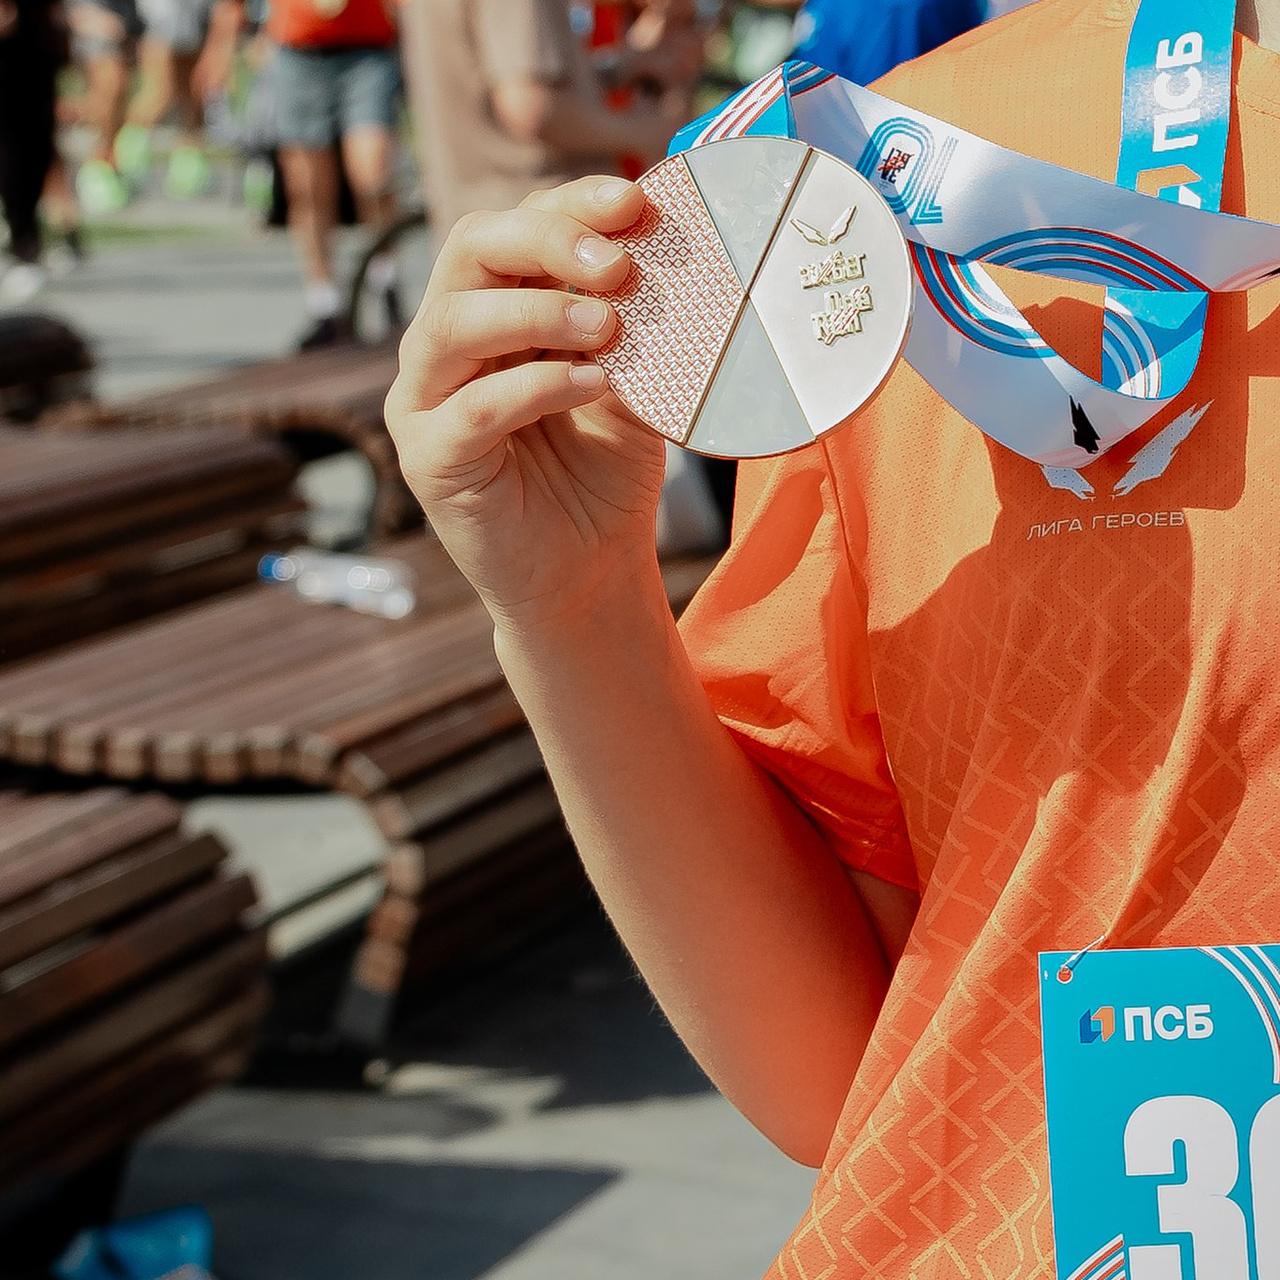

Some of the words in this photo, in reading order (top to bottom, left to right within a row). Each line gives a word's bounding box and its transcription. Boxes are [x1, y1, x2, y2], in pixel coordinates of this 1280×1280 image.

[1152, 31, 1203, 152] ПСБ
[1027, 517, 1083, 541] ЛИГА
[1092, 511, 1186, 530] ГЕРОЕВ
[1123, 1004, 1214, 1042] ПСБ
